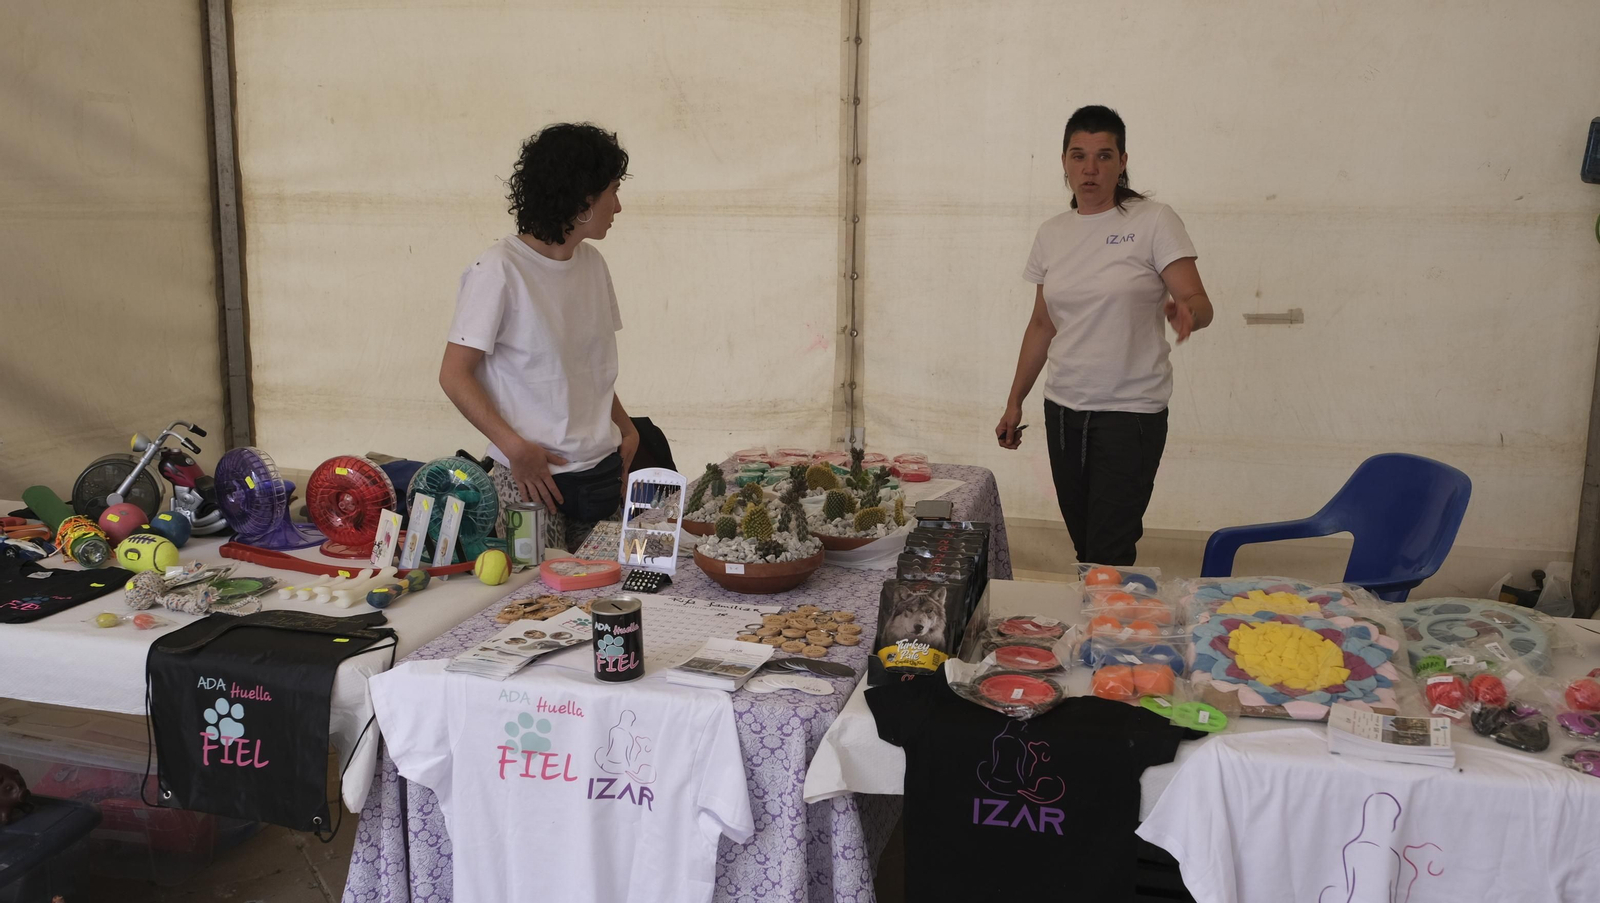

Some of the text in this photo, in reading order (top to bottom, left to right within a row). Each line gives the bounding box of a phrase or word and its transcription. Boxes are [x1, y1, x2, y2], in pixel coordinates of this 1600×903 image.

[1106, 233, 1135, 244] IZAR
[594, 621, 611, 632] ADA
[612, 622, 640, 635] Huella
[896, 638, 930, 655] Turkey
[596, 652, 640, 673] FIEL
[197, 676, 272, 701] ADA Huella
[498, 688, 585, 718] ADA Huella
[200, 732, 270, 768] FIEL
[497, 745, 655, 812] FIEL IZAR
[973, 798, 1065, 836] IZAR
